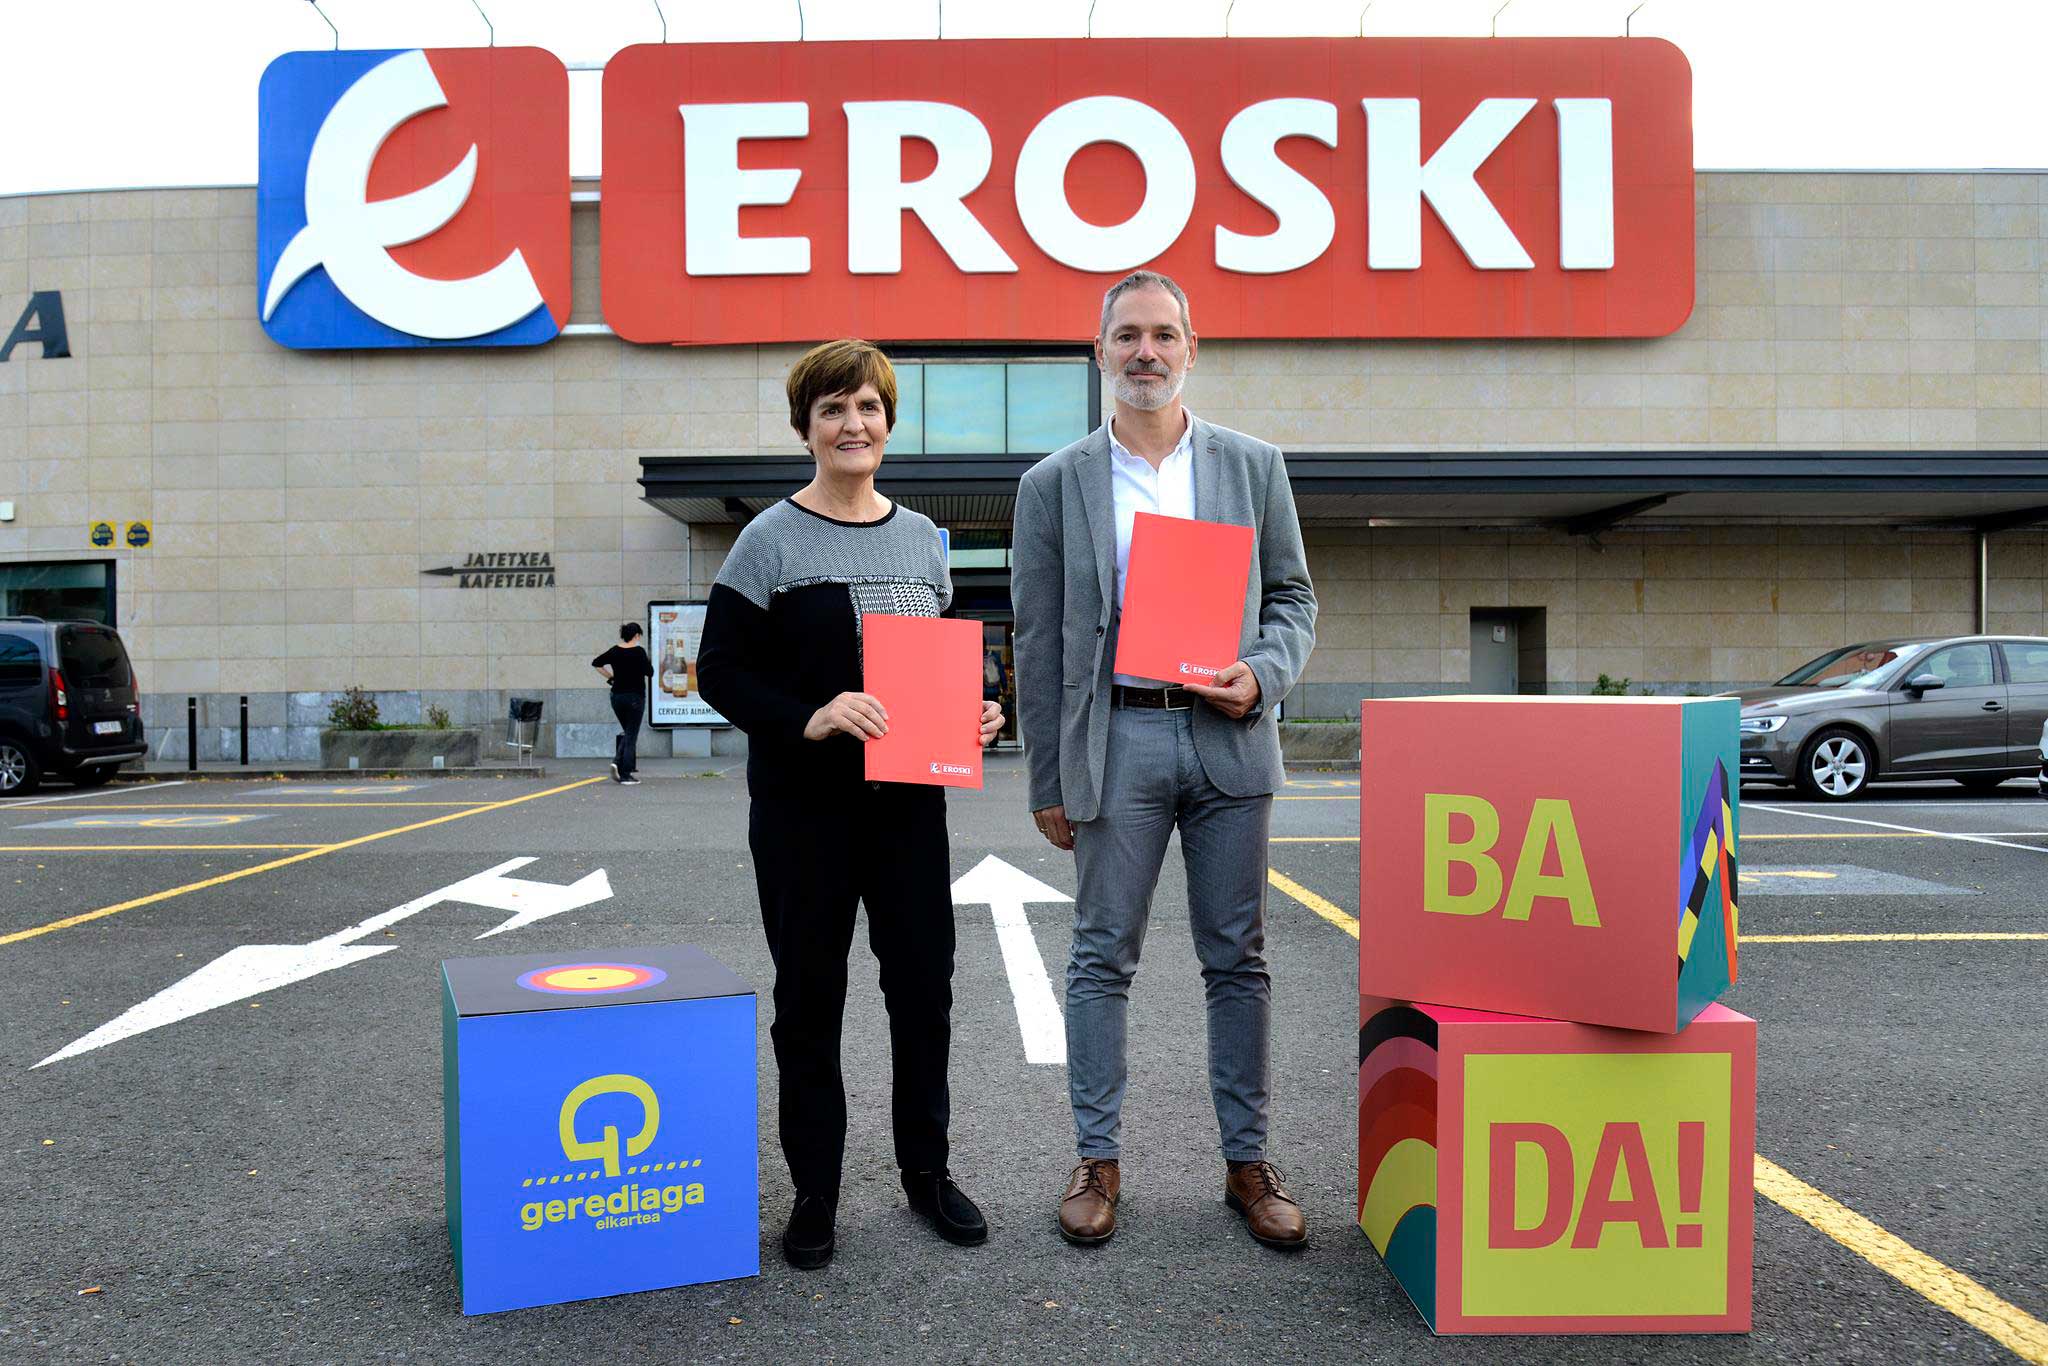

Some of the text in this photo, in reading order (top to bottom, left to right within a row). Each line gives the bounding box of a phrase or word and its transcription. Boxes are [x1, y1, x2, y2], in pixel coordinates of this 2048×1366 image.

[677, 95, 1616, 276] EROSKI
[0, 290, 71, 362] A
[463, 552, 550, 567] JATETXEA
[459, 574, 555, 588] KAFETEGIA
[1193, 665, 1219, 677] EROSK
[658, 707, 689, 716] CERVEZAS
[943, 765, 971, 775] EROSKI
[1424, 793, 1602, 928] BA
[1488, 1121, 1705, 1249] DA!
[520, 1182, 705, 1231] gerediaga
[595, 1212, 661, 1230] elkartea
